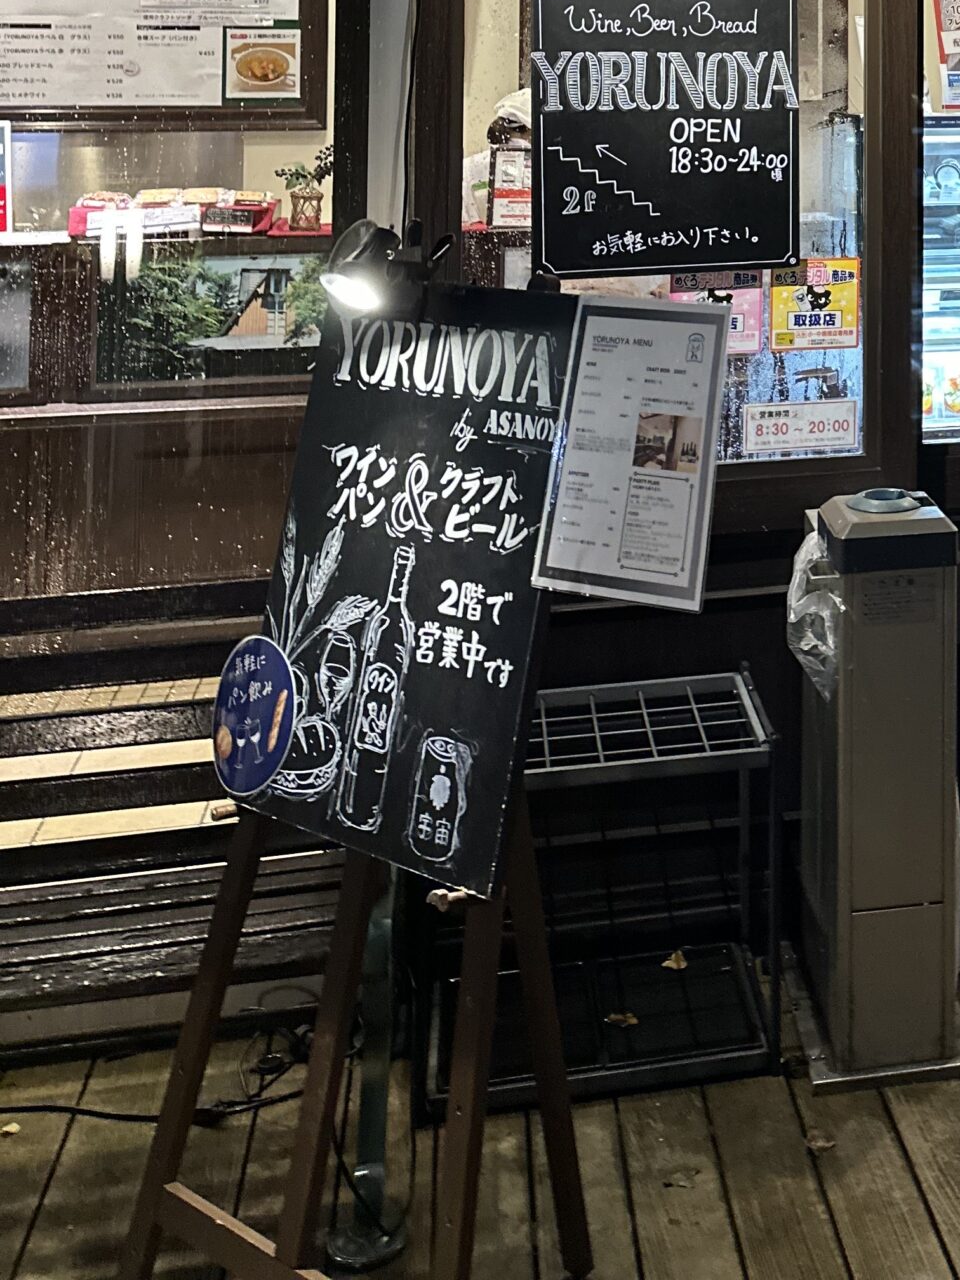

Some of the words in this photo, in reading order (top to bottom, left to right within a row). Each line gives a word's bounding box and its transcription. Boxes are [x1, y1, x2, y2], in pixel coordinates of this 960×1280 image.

[531, 50, 799, 111] YORUNOYA
[669, 117, 741, 144] OPEN
[592, 226, 759, 256] お気軽にお入り下さい。
[793, 313, 837, 328] 取扱店
[592, 335, 630, 345] YORUNOYA
[632, 338, 653, 347] MENU
[337, 317, 552, 407] YORUNOYA
[453, 407, 478, 453] by
[759, 409, 790, 419] 営業時間
[809, 419, 850, 434] 20:00
[335, 446, 396, 488] ワイン
[391, 459, 438, 533] &
[440, 466, 518, 510] クラフト
[333, 483, 386, 521] パン
[445, 503, 528, 549] ビール
[438, 579, 514, 625] 2階で
[416, 621, 514, 688] 営業中です
[228, 680, 273, 709] パン飲み
[368, 670, 396, 694] ワイン
[418, 812, 451, 846] 宇宙
